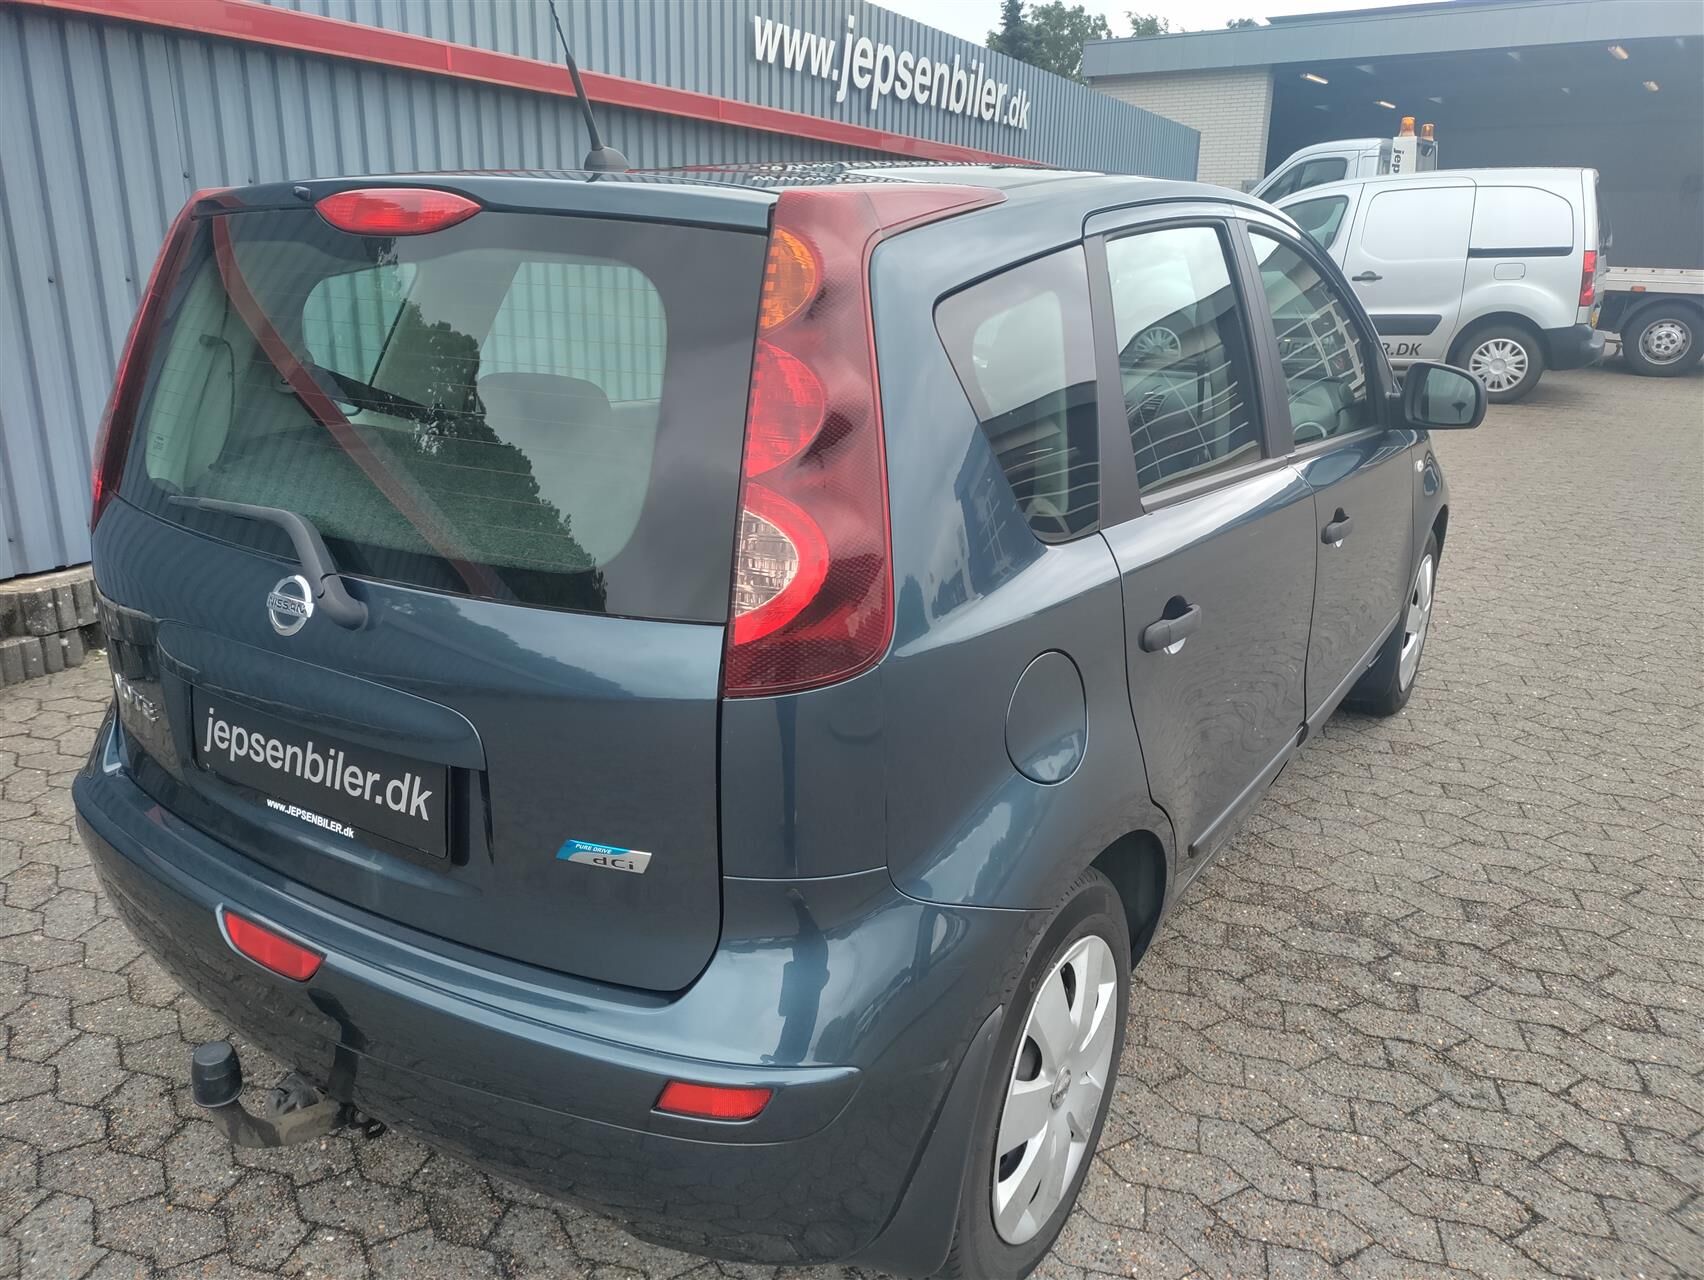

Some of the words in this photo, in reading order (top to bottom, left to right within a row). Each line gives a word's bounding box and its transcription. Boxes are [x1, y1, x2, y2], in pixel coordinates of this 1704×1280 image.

[754, 15, 1030, 130] www.jepsenbiler.dk
[269, 595, 306, 614] NISSAN
[203, 708, 433, 822] jepsenbiler.dk
[266, 798, 355, 839] www.JEPSENBILER.dk
[575, 843, 592, 852] PURE
[592, 846, 612, 855] DRIVE
[593, 857, 634, 870] dCi
